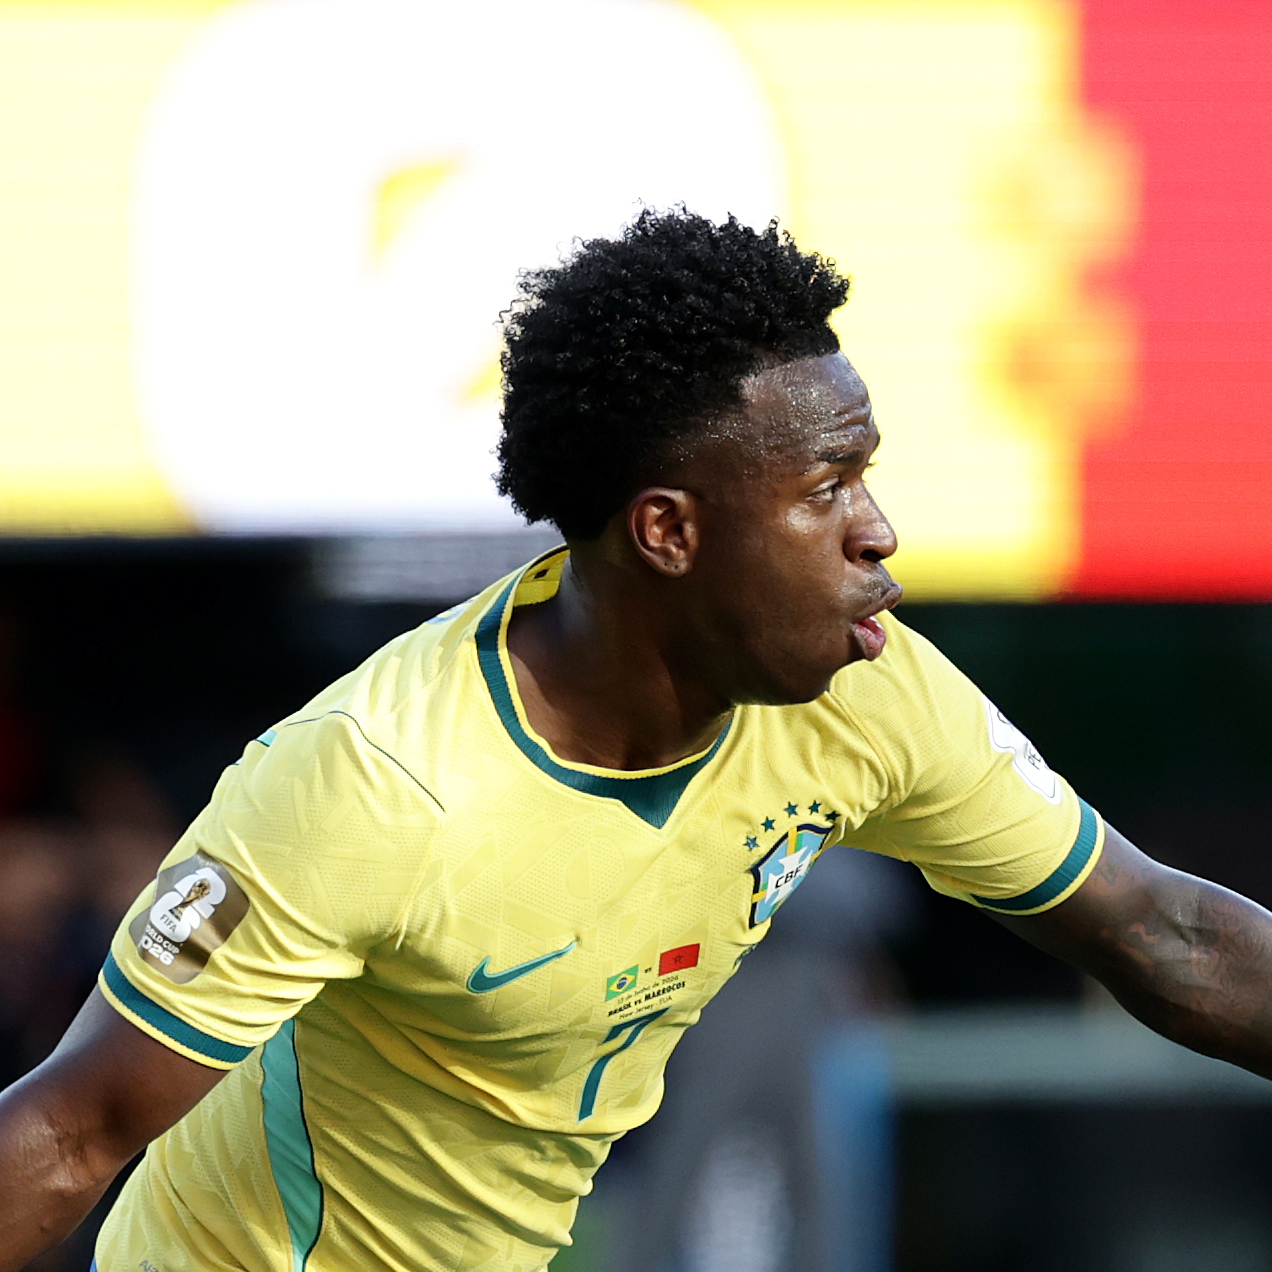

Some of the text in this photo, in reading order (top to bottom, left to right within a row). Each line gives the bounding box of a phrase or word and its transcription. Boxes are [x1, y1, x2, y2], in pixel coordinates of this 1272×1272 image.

[774, 864, 803, 889] CBF
[160, 913, 177, 933] FIFA
[140, 935, 175, 965] 026
[145, 924, 180, 954] ORLD CUP
[644, 981, 686, 1001] MARROCOS
[577, 1006, 672, 1124] 7
